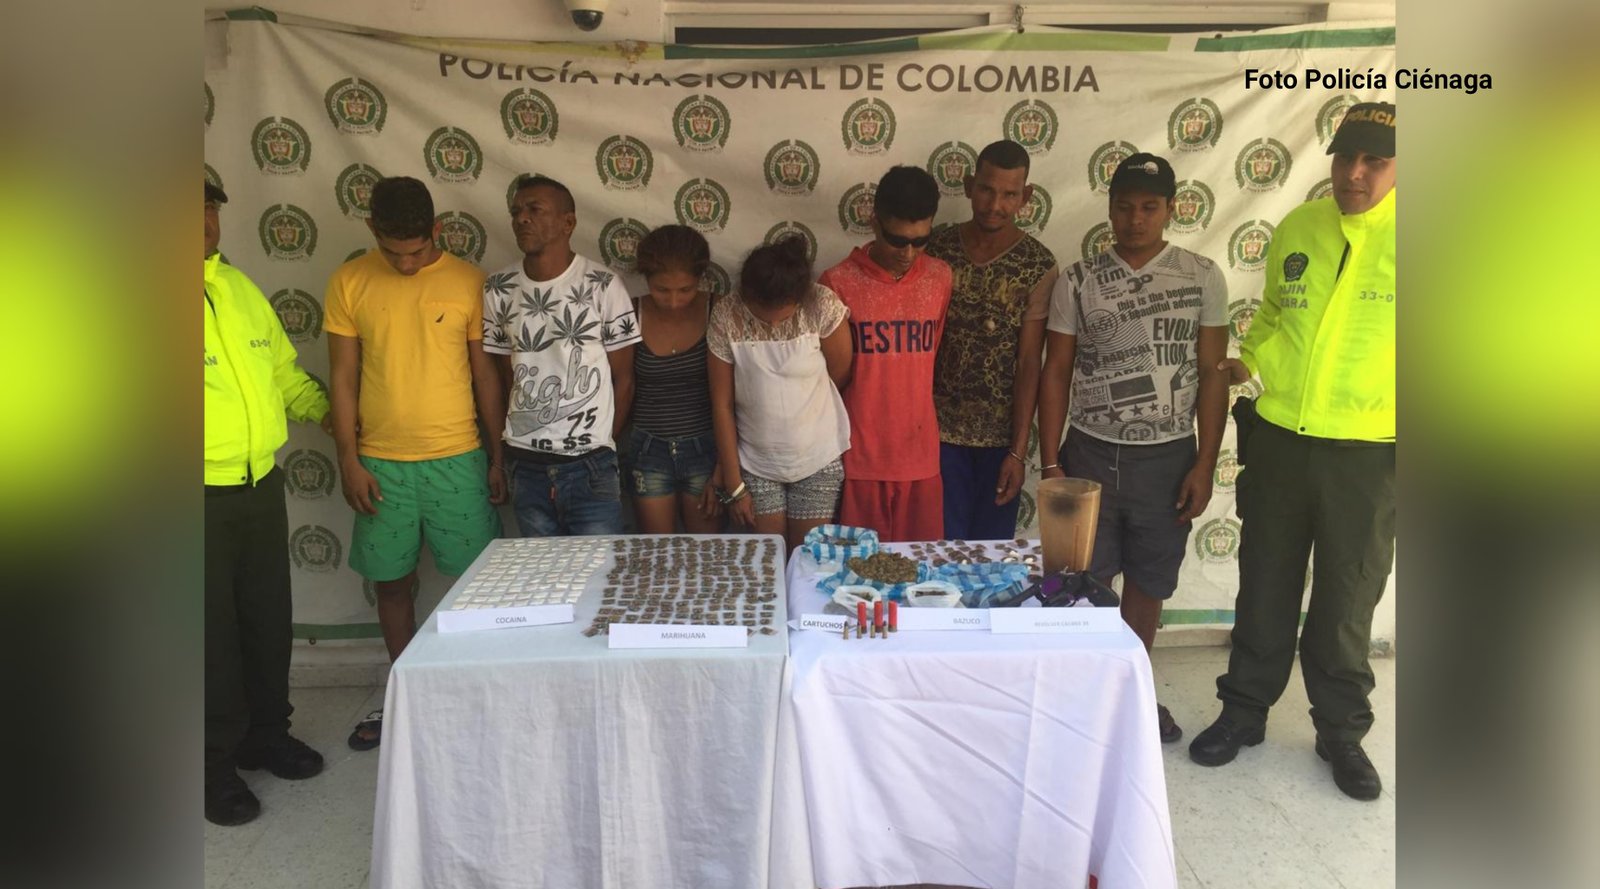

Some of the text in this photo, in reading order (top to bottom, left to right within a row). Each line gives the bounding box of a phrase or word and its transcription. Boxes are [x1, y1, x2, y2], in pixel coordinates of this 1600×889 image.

[839, 63, 884, 90] DE
[896, 63, 1100, 92] COLOMBIA
[1137, 296, 1147, 306] is
[1148, 292, 1164, 302] the
[1129, 301, 1171, 320] beautiful
[567, 406, 598, 437] 75
[495, 616, 527, 624] COCAINA
[802, 619, 844, 630] CARTUCHOS
[952, 617, 981, 626] BAZUCO
[660, 631, 706, 640] MARIHUANA
